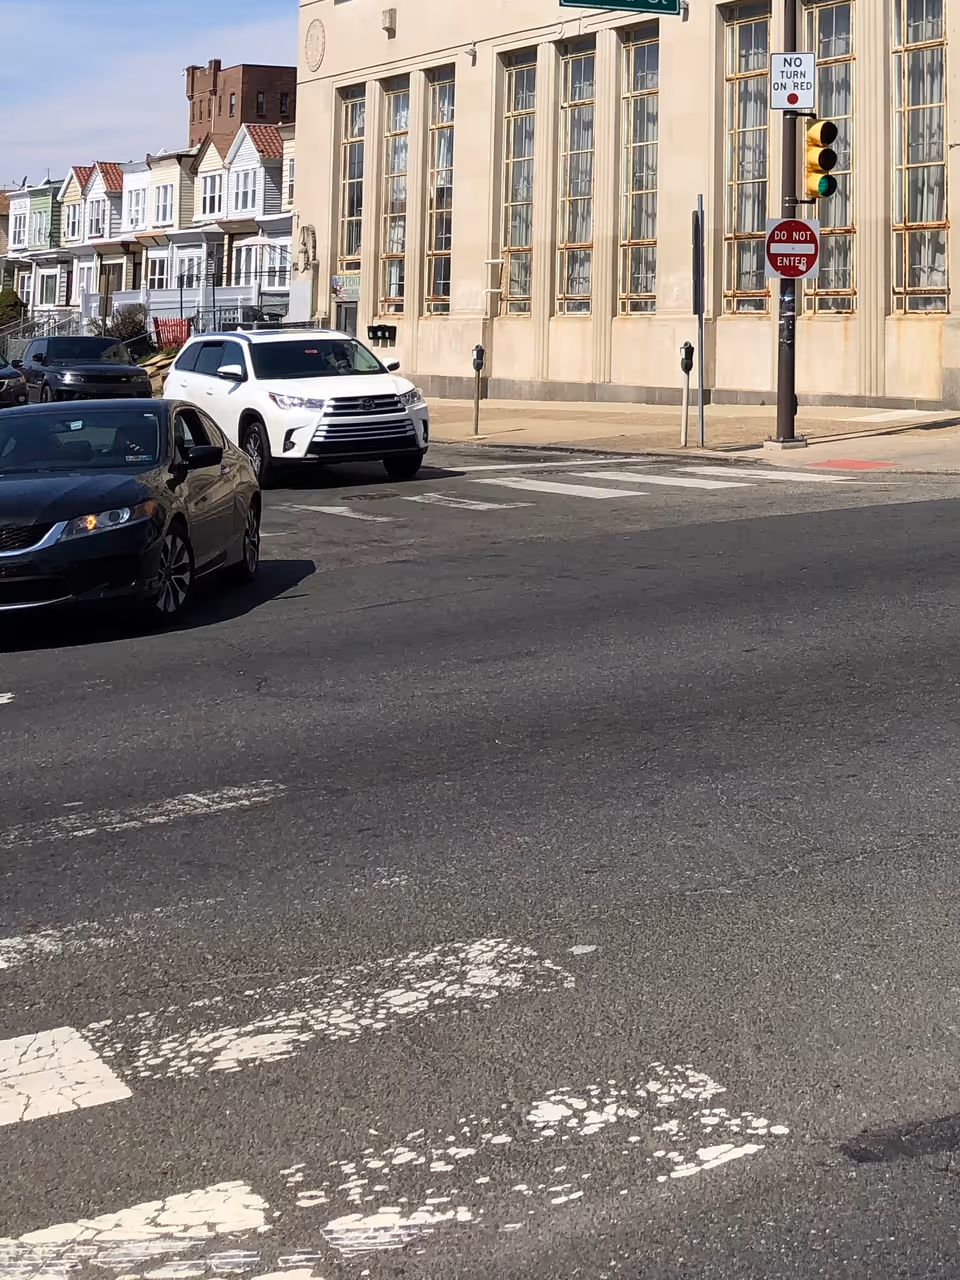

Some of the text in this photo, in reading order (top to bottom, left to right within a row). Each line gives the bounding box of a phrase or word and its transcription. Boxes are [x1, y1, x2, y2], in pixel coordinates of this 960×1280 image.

[783, 57, 803, 68] NO
[780, 70, 807, 80] TURN
[773, 81, 813, 91] ON RED
[774, 230, 811, 241] DO NOT
[777, 256, 807, 267] ENTER
